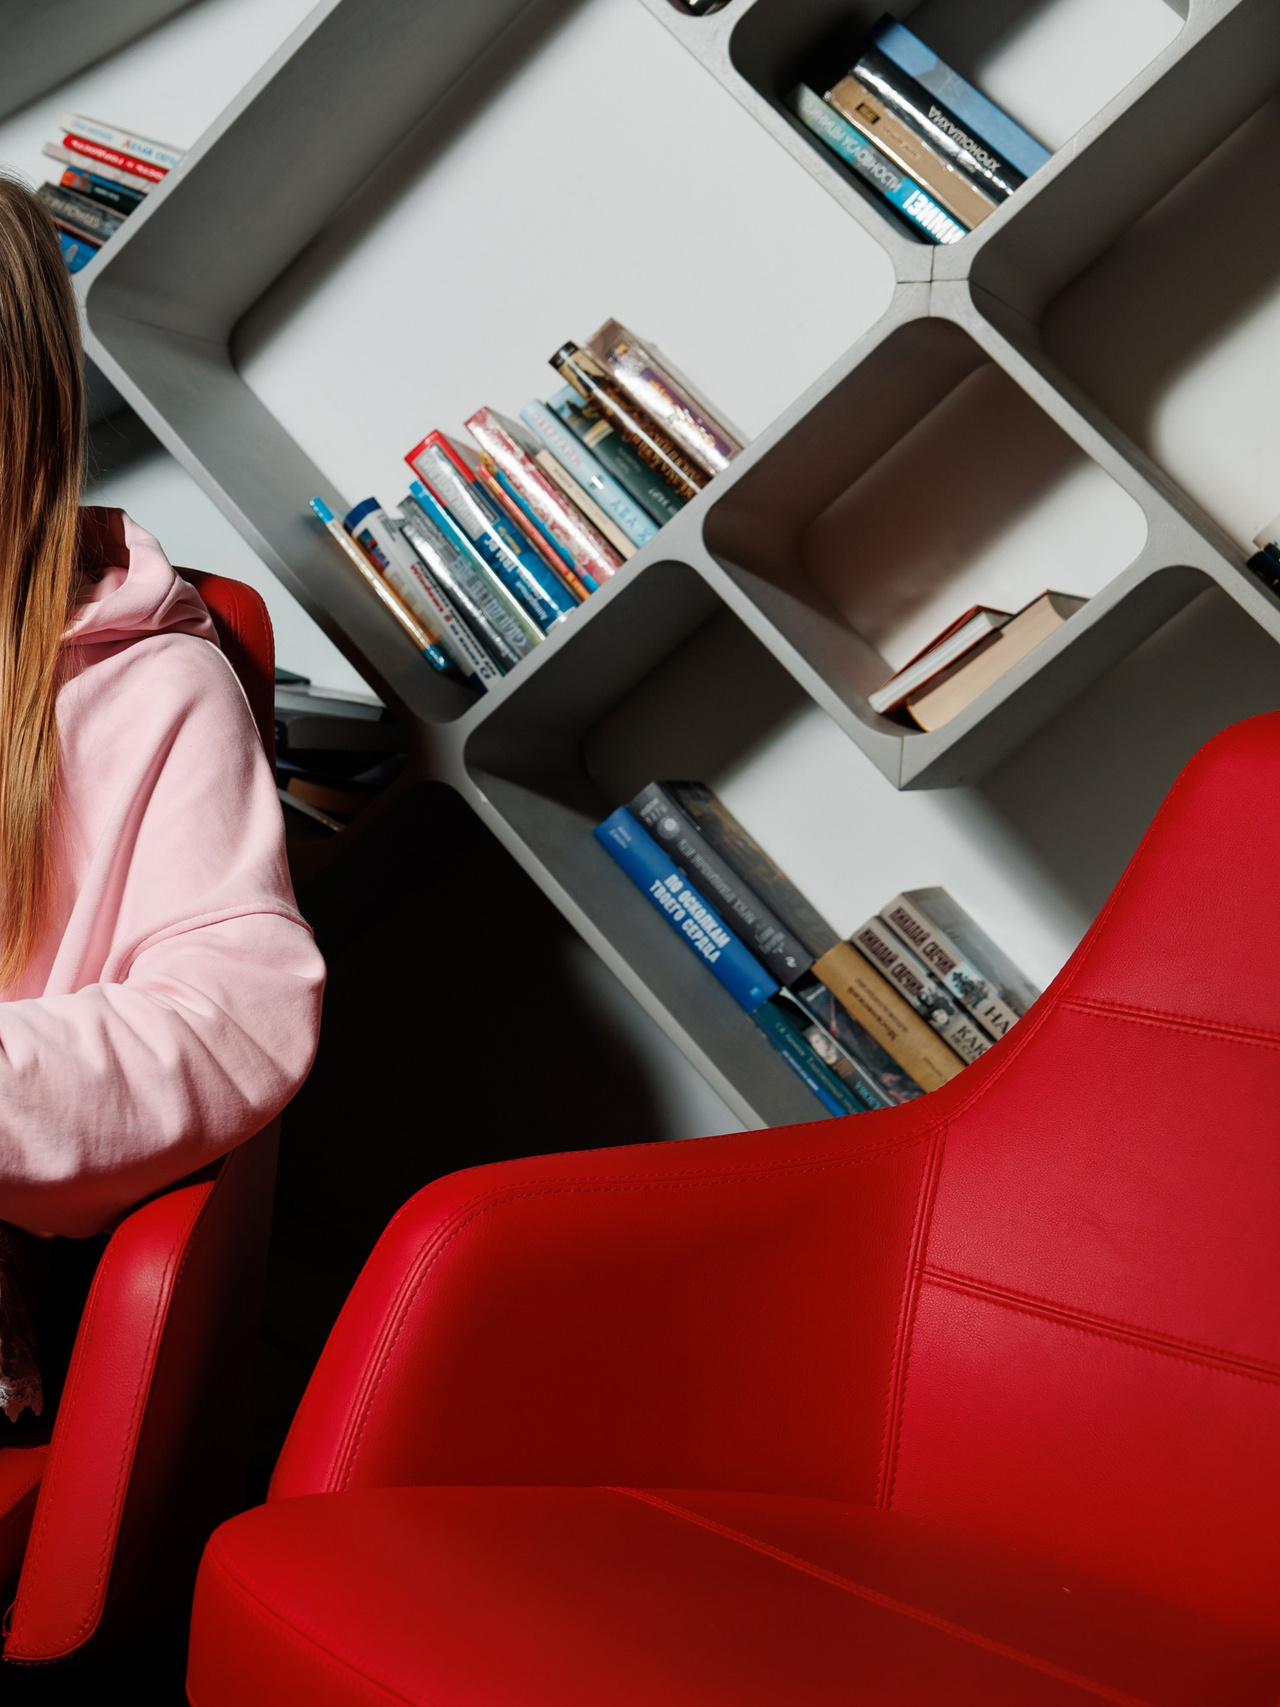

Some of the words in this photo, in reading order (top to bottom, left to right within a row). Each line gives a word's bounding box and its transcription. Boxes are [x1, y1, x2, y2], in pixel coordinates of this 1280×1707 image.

[840, 133, 903, 195] УСЛОВНОСТИ
[924, 104, 1001, 173] ХРОНОШАХИД
[609, 497, 639, 528] АВА
[408, 563, 445, 613] Windows
[513, 578, 549, 621] Аппаратные
[483, 659, 497, 676] для
[647, 878, 688, 922] ТВОЕГО
[679, 917, 722, 964] СЕРДЦА
[663, 872, 684, 894] ПО
[676, 889, 731, 949] ОСКОЛКАМ
[857, 927, 900, 968] НИКОЛАЙ
[889, 963, 924, 996] СВЕЧИН
[956, 1024, 988, 1057] КАК
[888, 905, 932, 947] НИКОЛАЙ
[921, 940, 957, 975] СВЕЧИН
[983, 1005, 1012, 1037] НА
[846, 984, 898, 1041] Московский
